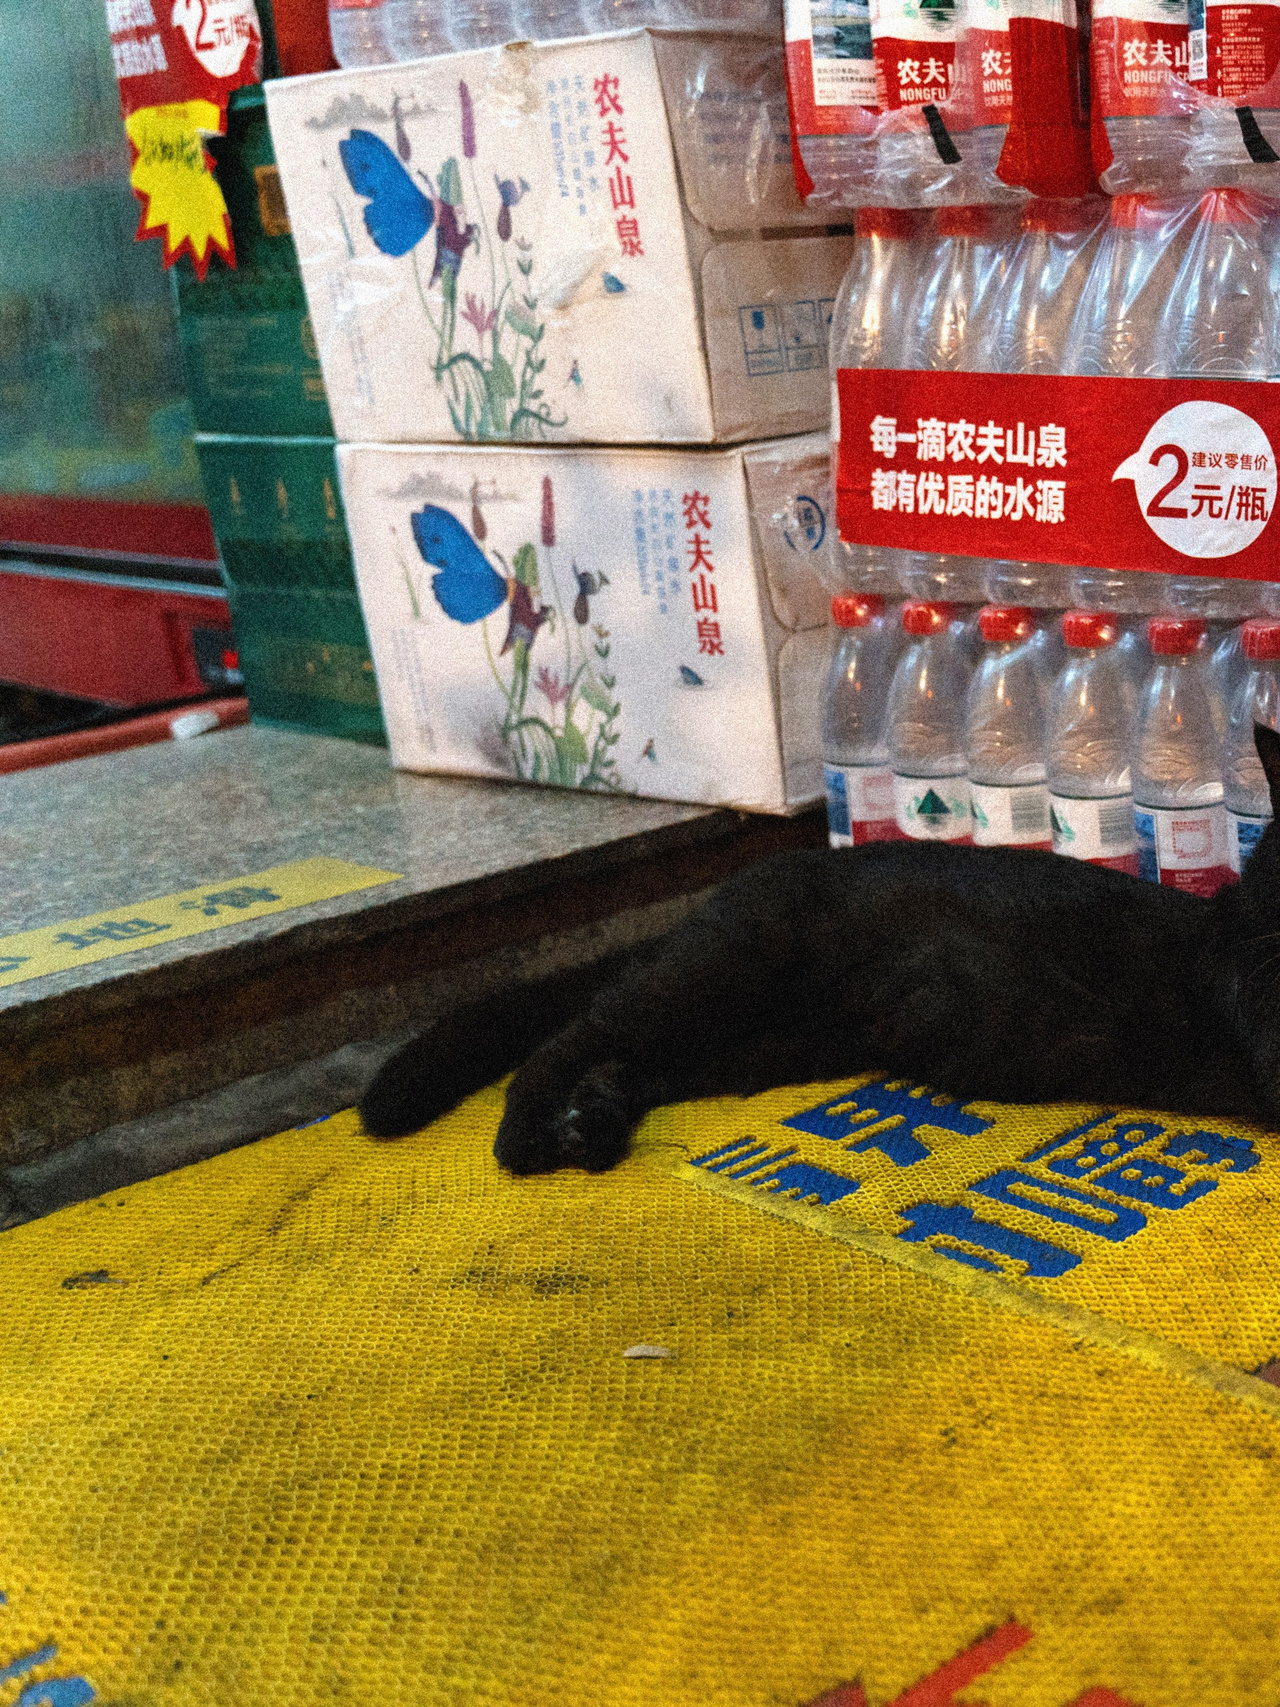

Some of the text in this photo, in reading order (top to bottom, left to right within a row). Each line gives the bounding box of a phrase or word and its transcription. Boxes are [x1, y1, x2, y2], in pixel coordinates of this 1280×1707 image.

[900, 87, 946, 102] NONGFU
[593, 73, 645, 257] 农夫山泉
[870, 415, 1067, 468] 每一滴农夫山泉
[1192, 451, 1268, 471] 建议零售价
[871, 468, 1066, 524] 都有优质的水源
[1147, 444, 1268, 521] 2元/瓶
[682, 490, 725, 656] 农夫山泉
